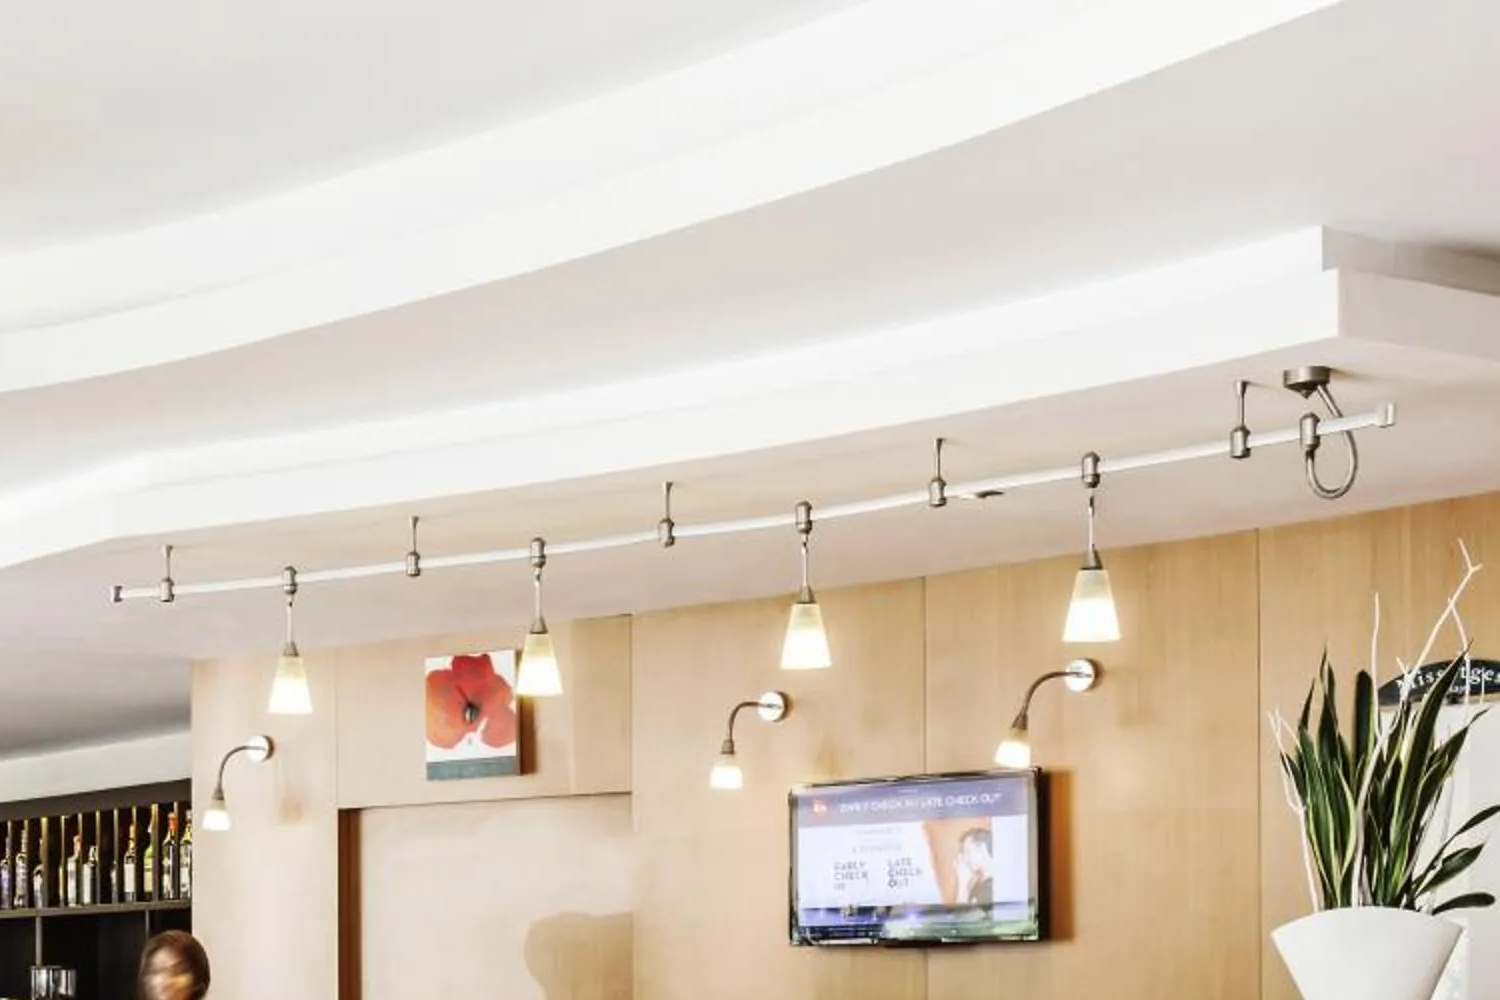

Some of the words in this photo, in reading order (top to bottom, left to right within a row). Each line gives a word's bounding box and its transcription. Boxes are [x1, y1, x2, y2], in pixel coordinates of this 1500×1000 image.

[945, 794, 978, 806] CHECK
[981, 791, 1002, 804] OUT
[833, 871, 868, 881] CHECK
[887, 867, 922, 877] CHECK
